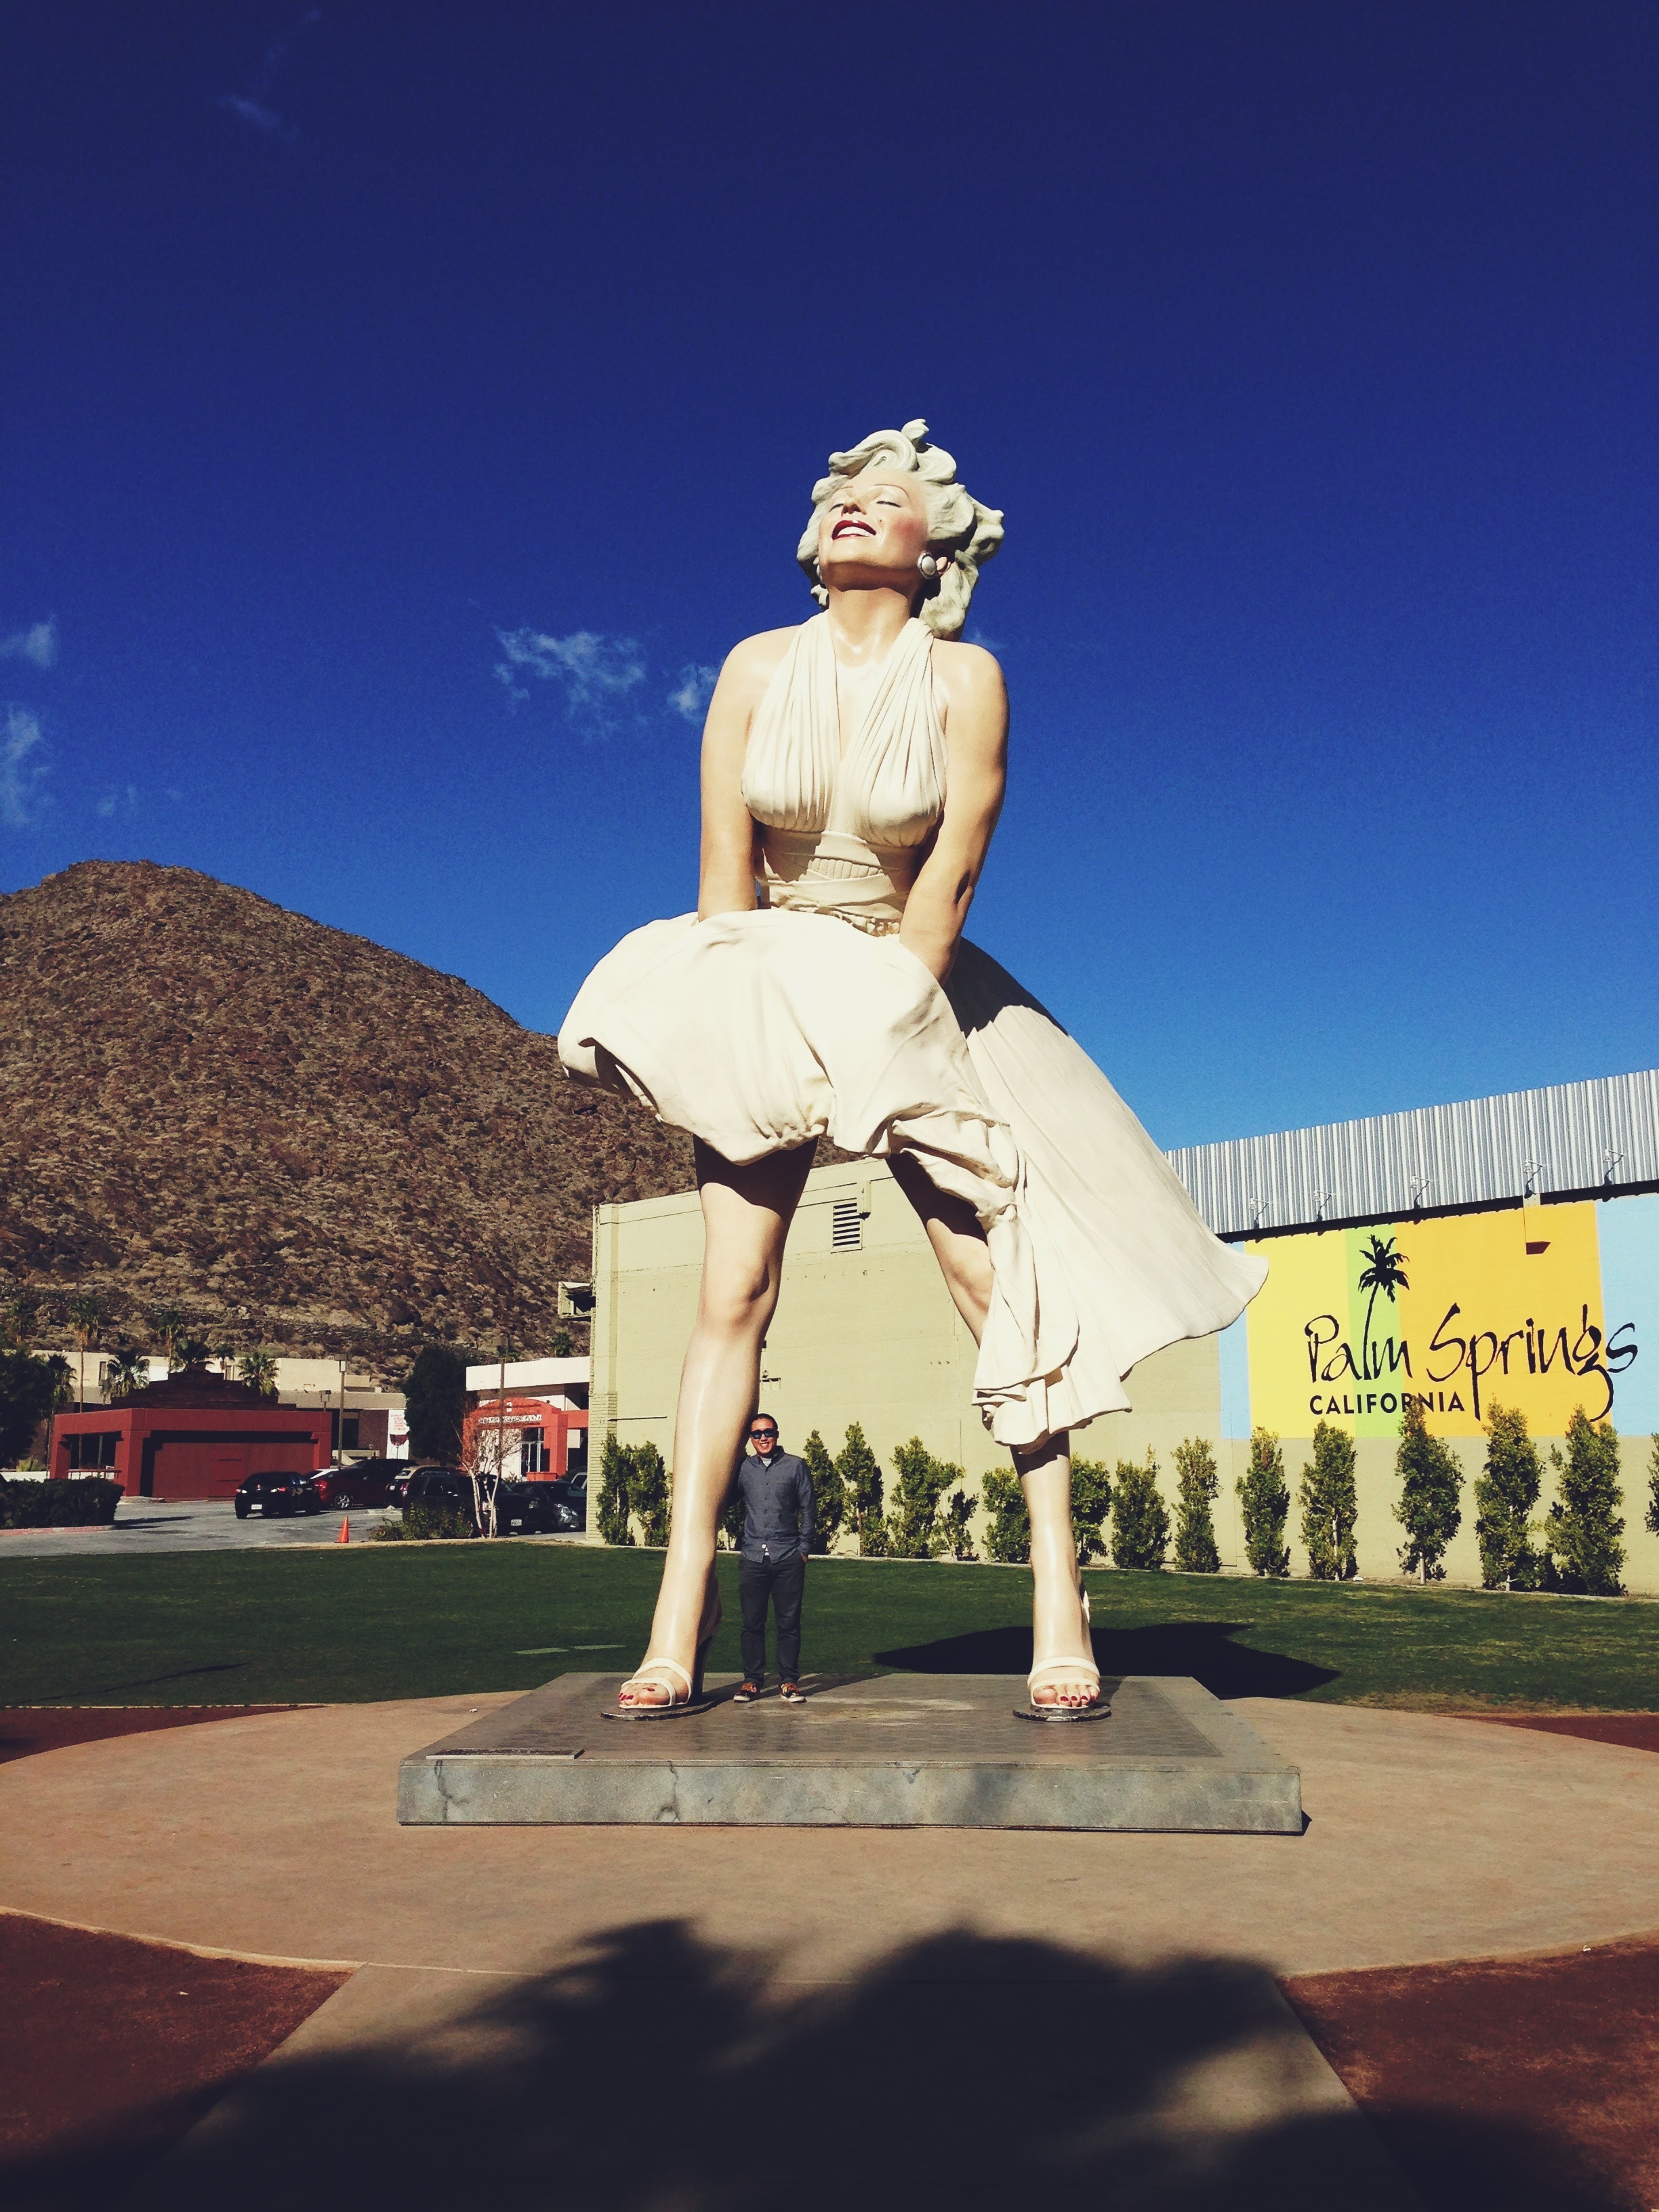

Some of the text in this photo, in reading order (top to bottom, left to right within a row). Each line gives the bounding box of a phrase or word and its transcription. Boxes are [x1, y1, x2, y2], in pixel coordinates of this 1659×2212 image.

[1304, 1303, 1638, 1422] Palm Springs
[1309, 1391, 1465, 1415] CALIFORNIA
